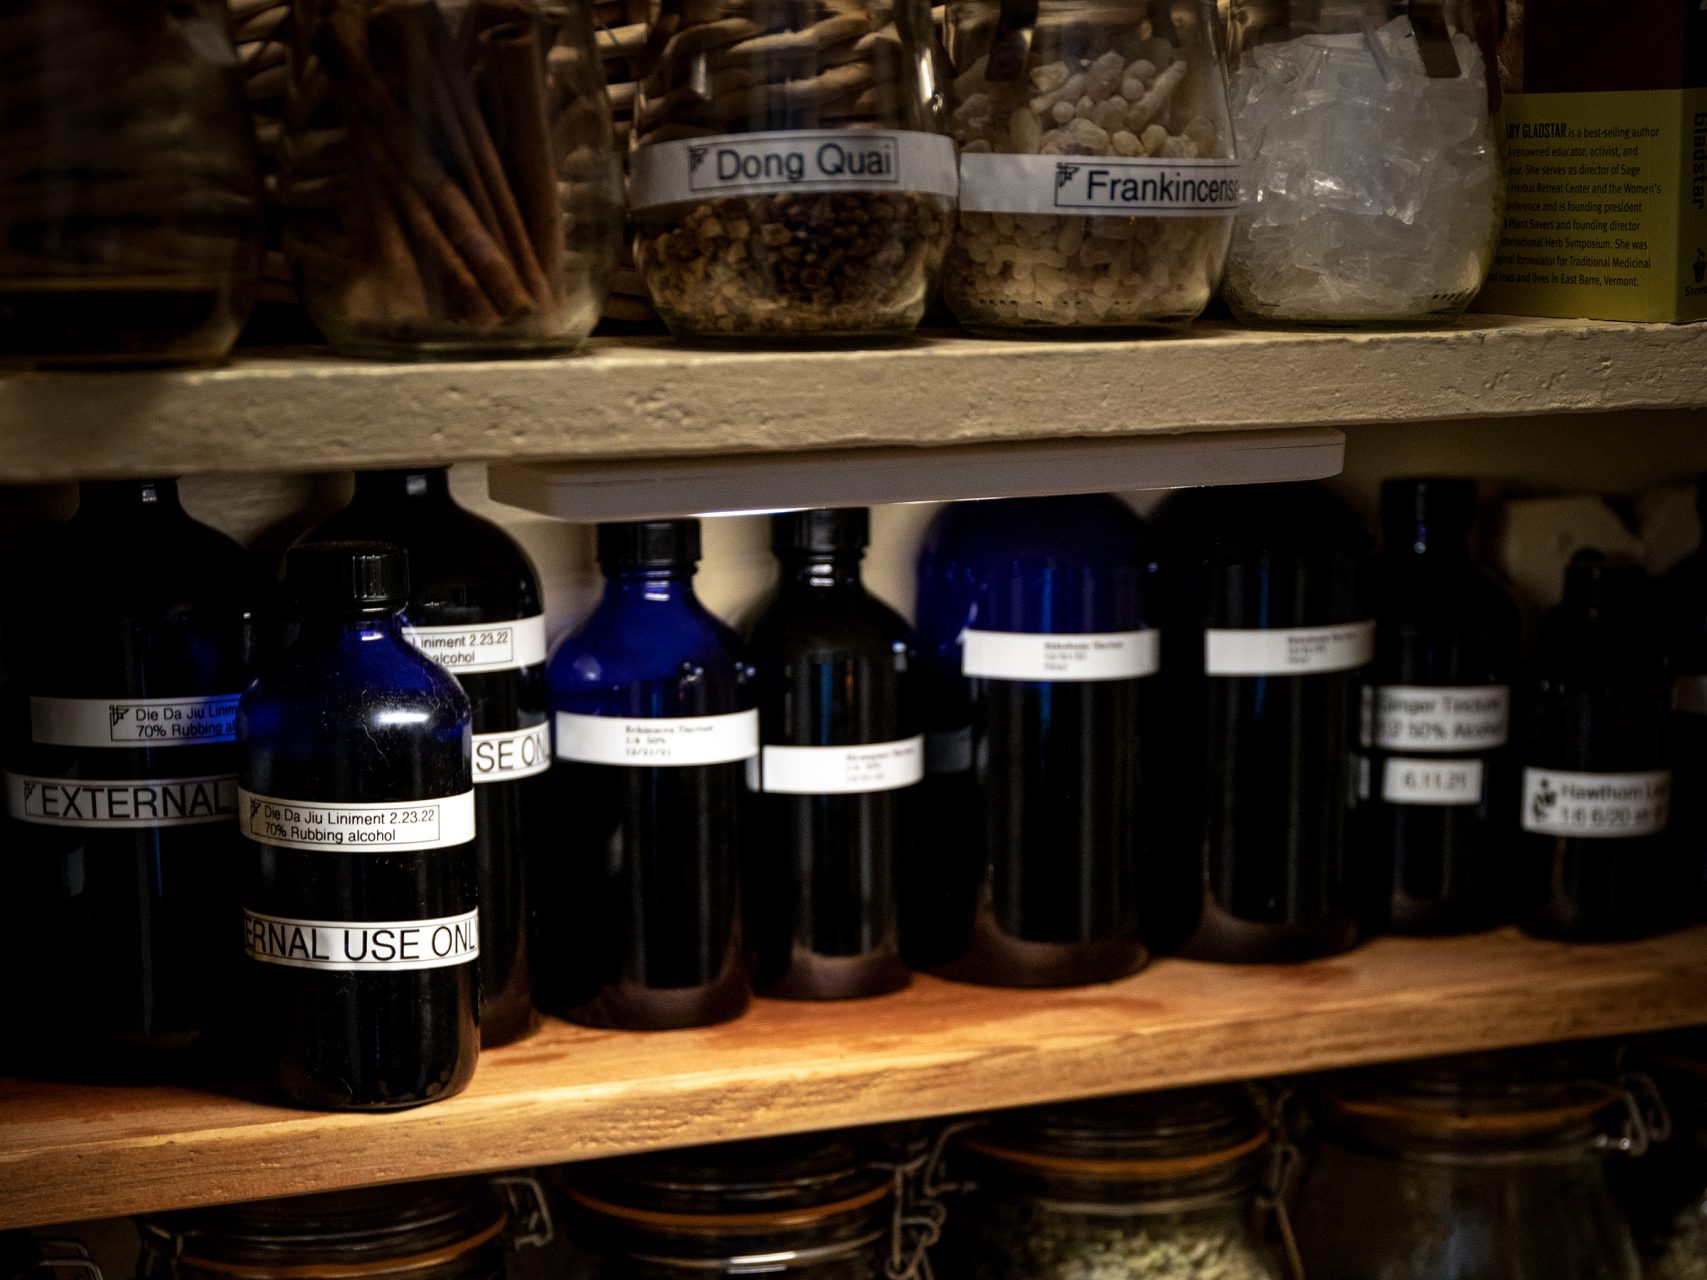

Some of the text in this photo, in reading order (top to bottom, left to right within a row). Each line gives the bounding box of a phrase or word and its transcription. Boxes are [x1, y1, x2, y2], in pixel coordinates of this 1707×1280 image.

[1522, 123, 1567, 138] GLADSTAR
[1568, 128, 1575, 137] is
[1583, 126, 1630, 140] best-selling
[1631, 126, 1660, 137] author
[1552, 146, 1588, 158] educator,
[1590, 145, 1621, 157] activist,
[1623, 145, 1639, 156] and
[717, 143, 892, 182] Dong Quai
[1692, 113, 1707, 209] Gladstar
[1526, 165, 1540, 175] She
[1541, 167, 1567, 175] serves
[1568, 167, 1577, 175] as
[1579, 164, 1609, 175] director
[1611, 164, 1620, 175] of
[1621, 164, 1640, 177] Sage
[1511, 183, 1535, 193] Herbal
[1537, 183, 1563, 193] Retreat
[1565, 182, 1590, 193] Center
[1592, 183, 1607, 193] and
[1609, 183, 1622, 193] the
[1623, 183, 1662, 194] Women's
[1542, 201, 1557, 211] and
[1559, 202, 1566, 211] is
[1567, 201, 1602, 214] founding
[1604, 202, 1642, 214] president
[1529, 219, 1554, 229] Savers
[1556, 219, 1571, 229] and
[1572, 220, 1607, 232] founding
[1609, 220, 1640, 231] director
[1545, 238, 1563, 248] Herb
[1565, 238, 1613, 250] Symposium.
[1615, 239, 1630, 249] She
[1632, 241, 1648, 250] was
[1517, 254, 1555, 265] formulator
[1557, 255, 1567, 265] for
[1569, 256, 1610, 268] Traditional
[1612, 257, 1651, 270] Medicinal
[1516, 272, 1530, 282] and
[1532, 272, 1550, 283] lives
[1551, 273, 1559, 283] in
[1560, 273, 1577, 284] East
[1578, 274, 1602, 286] Barre,
[1604, 276, 1639, 287] Vermont.
[469, 631, 509, 646] 2.23.22
[136, 708, 159, 721] Die
[163, 707, 182, 720] Da
[186, 706, 205, 720] Jiu
[136, 725, 167, 737] 70%
[172, 723, 222, 739] Rubbing
[41, 782, 233, 818] EXTERNAL
[264, 806, 435, 825] Die Da Jiu Liniment 2.23.22
[264, 822, 396, 844] 70% Rubbing alcohol
[343, 929, 420, 961] USE
